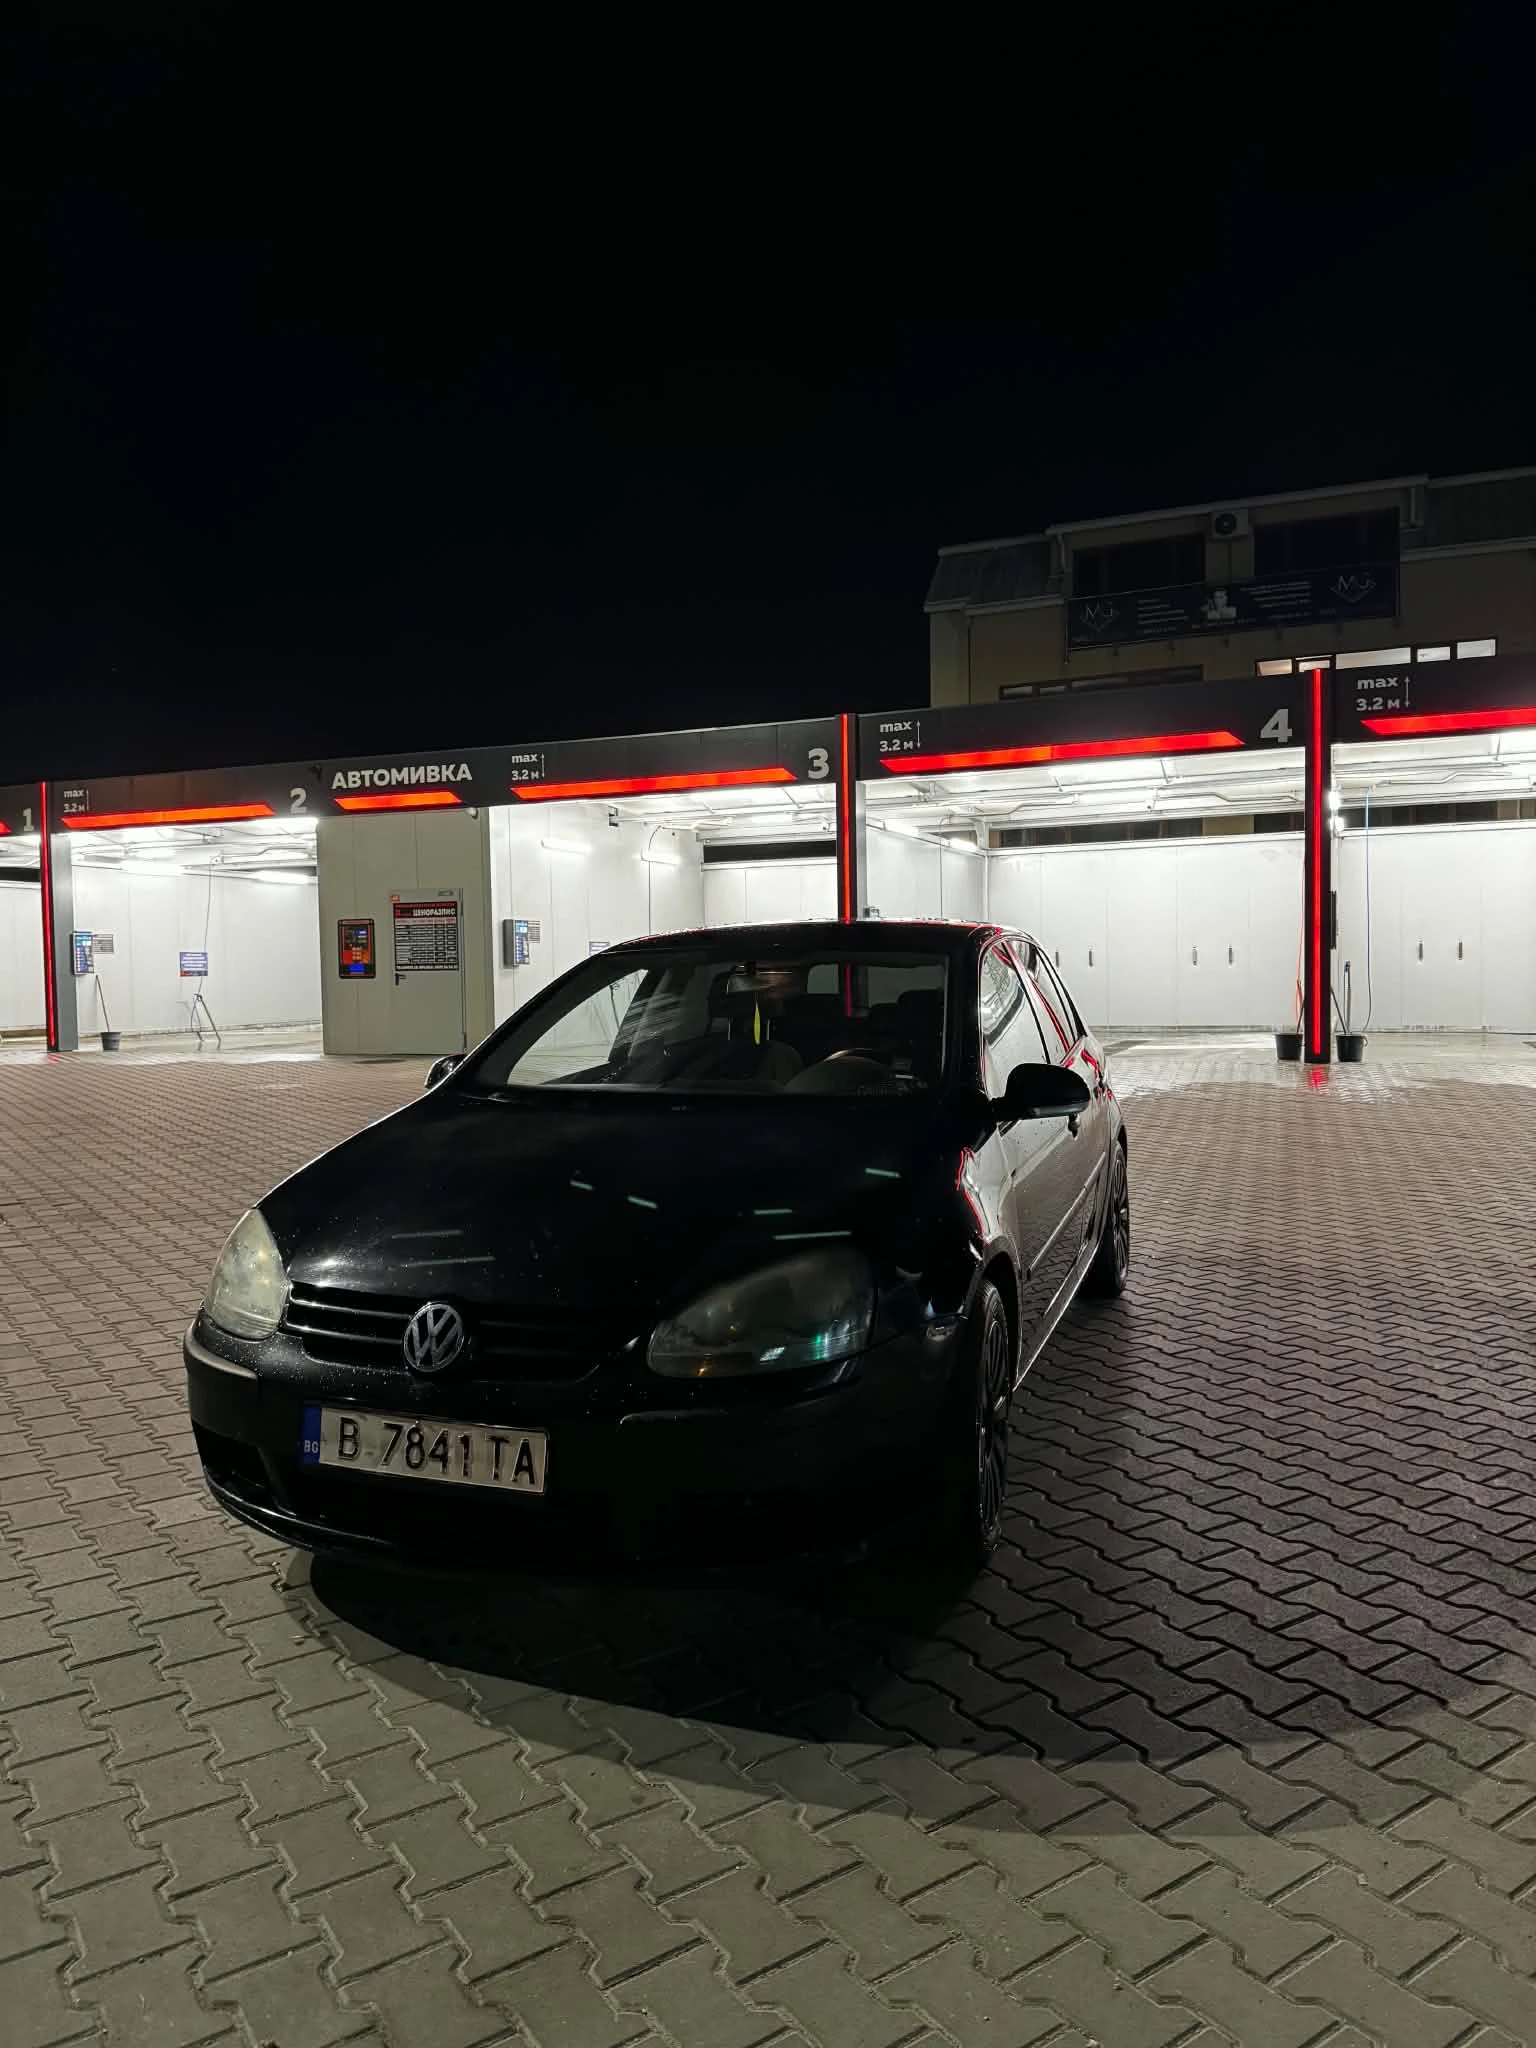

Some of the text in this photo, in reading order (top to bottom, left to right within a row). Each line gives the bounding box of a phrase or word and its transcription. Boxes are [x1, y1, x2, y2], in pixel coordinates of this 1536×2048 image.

[1357, 677, 1399, 690] max
[1356, 697, 1384, 712] 3.2
[879, 721, 912, 733] max
[1260, 708, 1293, 743] 4
[879, 739, 901, 752] 3.2
[511, 753, 538, 764] max
[807, 747, 830, 779] 3
[331, 763, 472, 790] АВТОМИВКА
[511, 770, 529, 781] 3.2
[63, 789, 84, 798] max
[289, 787, 307, 814] 2
[22, 807, 35, 832] 1
[304, 1441, 318, 1454] BG
[338, 1417, 535, 1484] B 7841 TA
